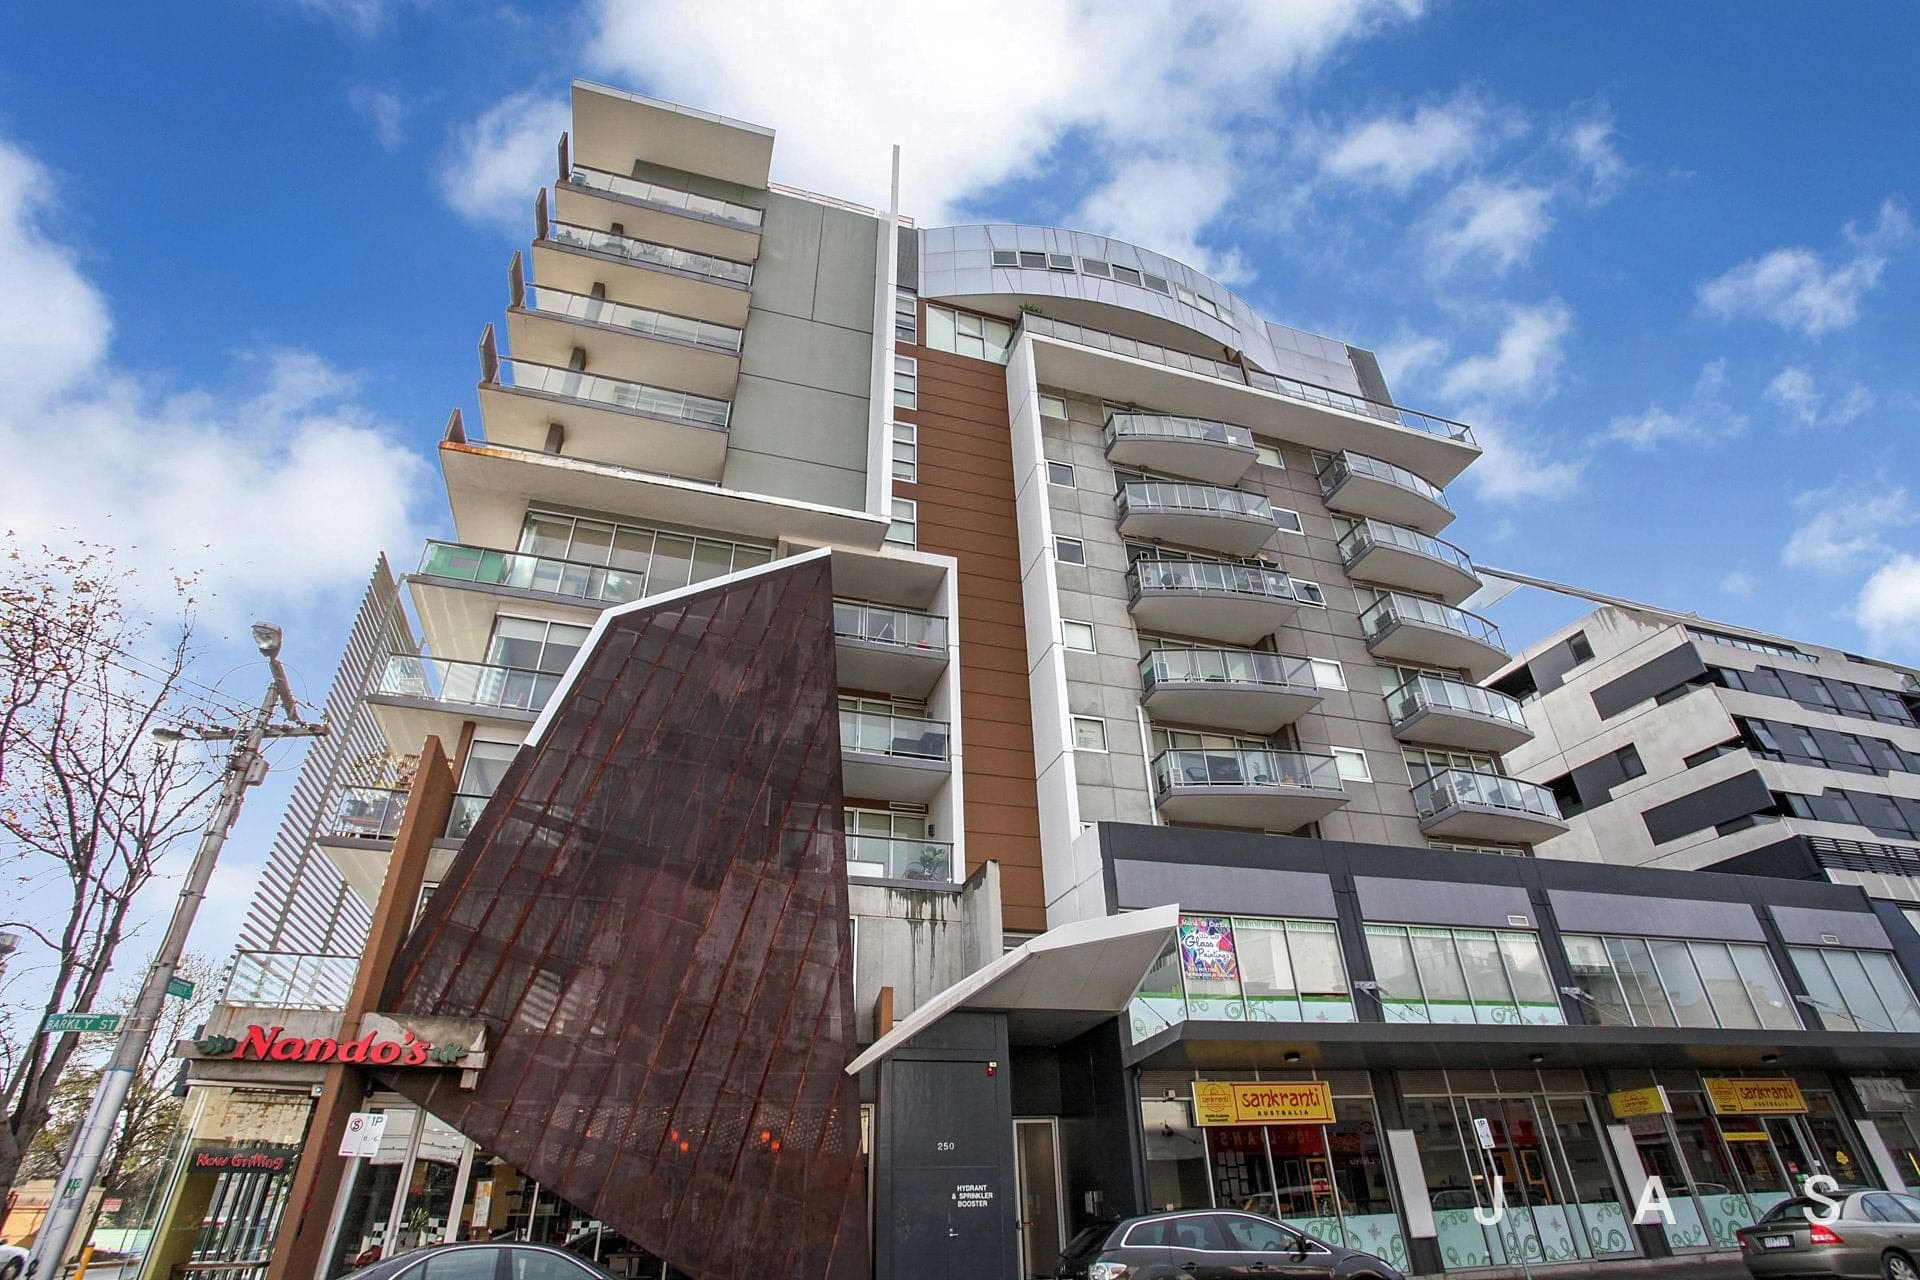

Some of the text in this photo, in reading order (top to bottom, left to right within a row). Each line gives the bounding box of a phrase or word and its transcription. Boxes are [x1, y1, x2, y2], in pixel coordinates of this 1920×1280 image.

[1185, 935, 1214, 947] Glass
[46, 1018, 118, 1031] BARKLY ST
[232, 1024, 433, 1065] Nando's
[1740, 1083, 1794, 1100] sankranti
[1241, 1088, 1321, 1108] sankranti
[937, 1142, 955, 1151] 250
[196, 1152, 229, 1167] Now
[956, 1184, 988, 1192] HYDRANT
[959, 1192, 993, 1200] SPRINKLER
[957, 1200, 988, 1208] BOOSTER
